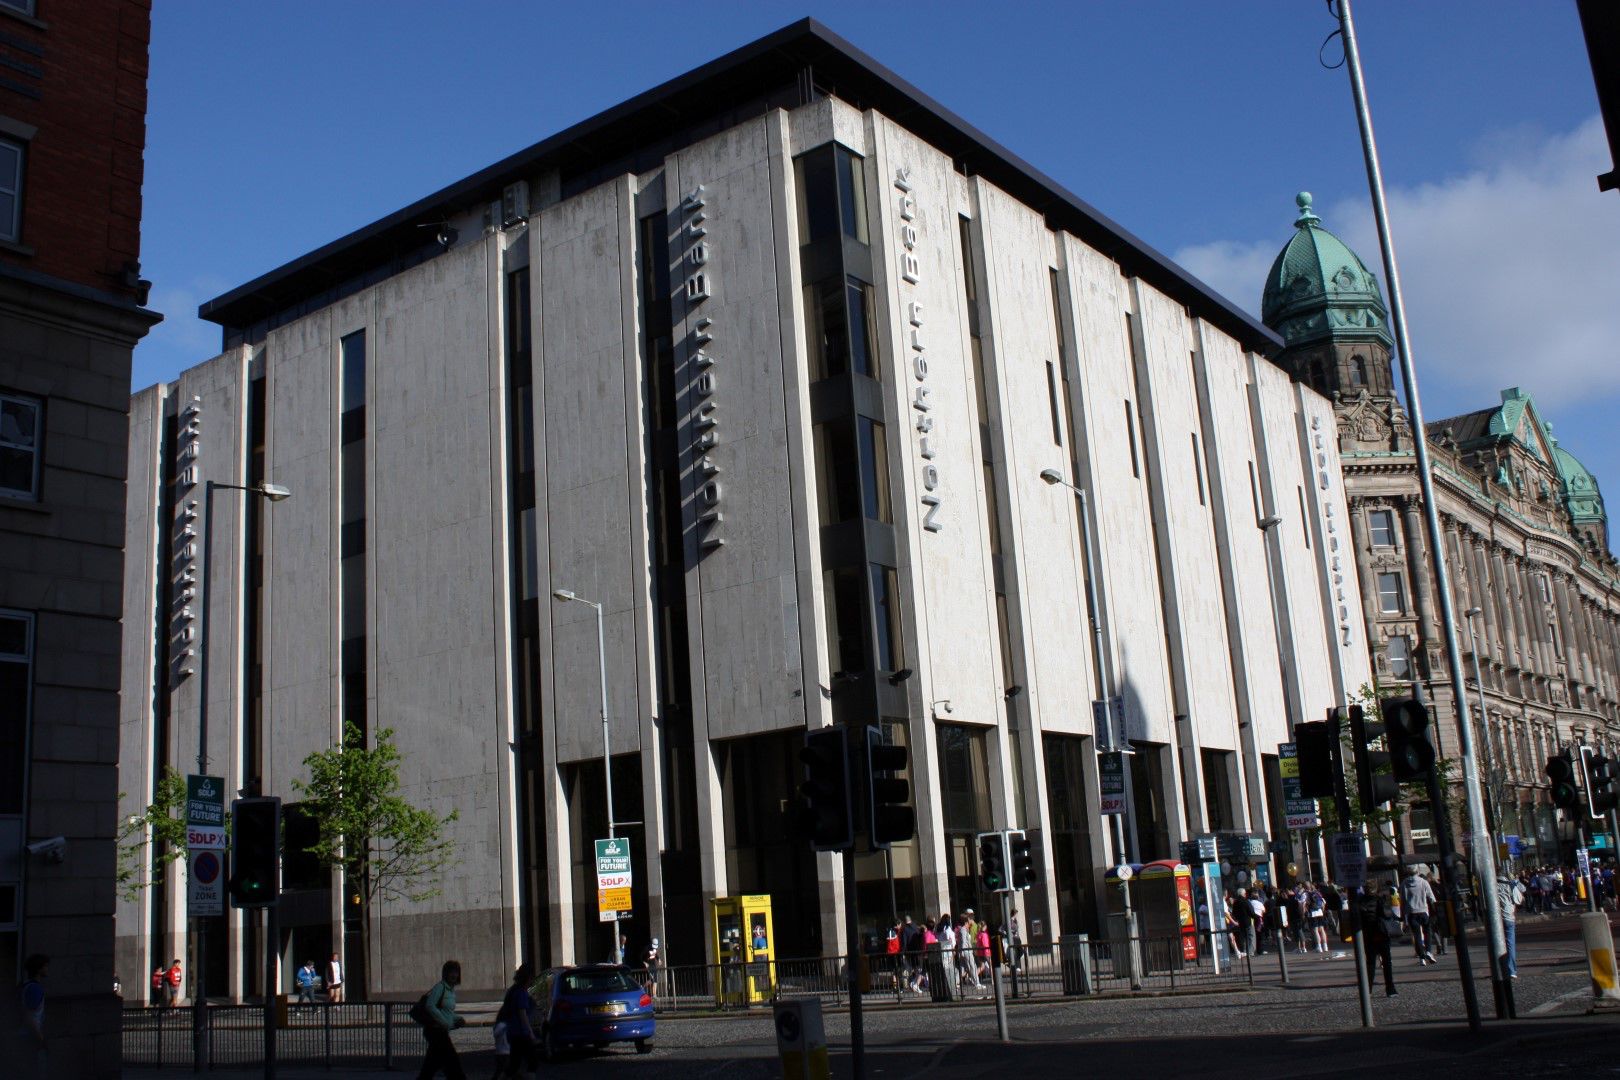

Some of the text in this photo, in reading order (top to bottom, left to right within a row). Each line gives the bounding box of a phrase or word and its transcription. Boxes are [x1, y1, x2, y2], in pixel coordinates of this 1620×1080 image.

[894, 167, 943, 534] Northern Bank
[684, 185, 725, 549] Northern Bank
[198, 789, 216, 797] SDLP
[191, 802, 222, 813] FOR YOUR
[1101, 800, 1119, 810] SDLP
[191, 810, 222, 822] FUTURE
[1288, 818, 1309, 826] SDLP
[189, 833, 216, 844] SDLP
[601, 877, 624, 886] SDLP
[195, 891, 217, 900] ZONE
